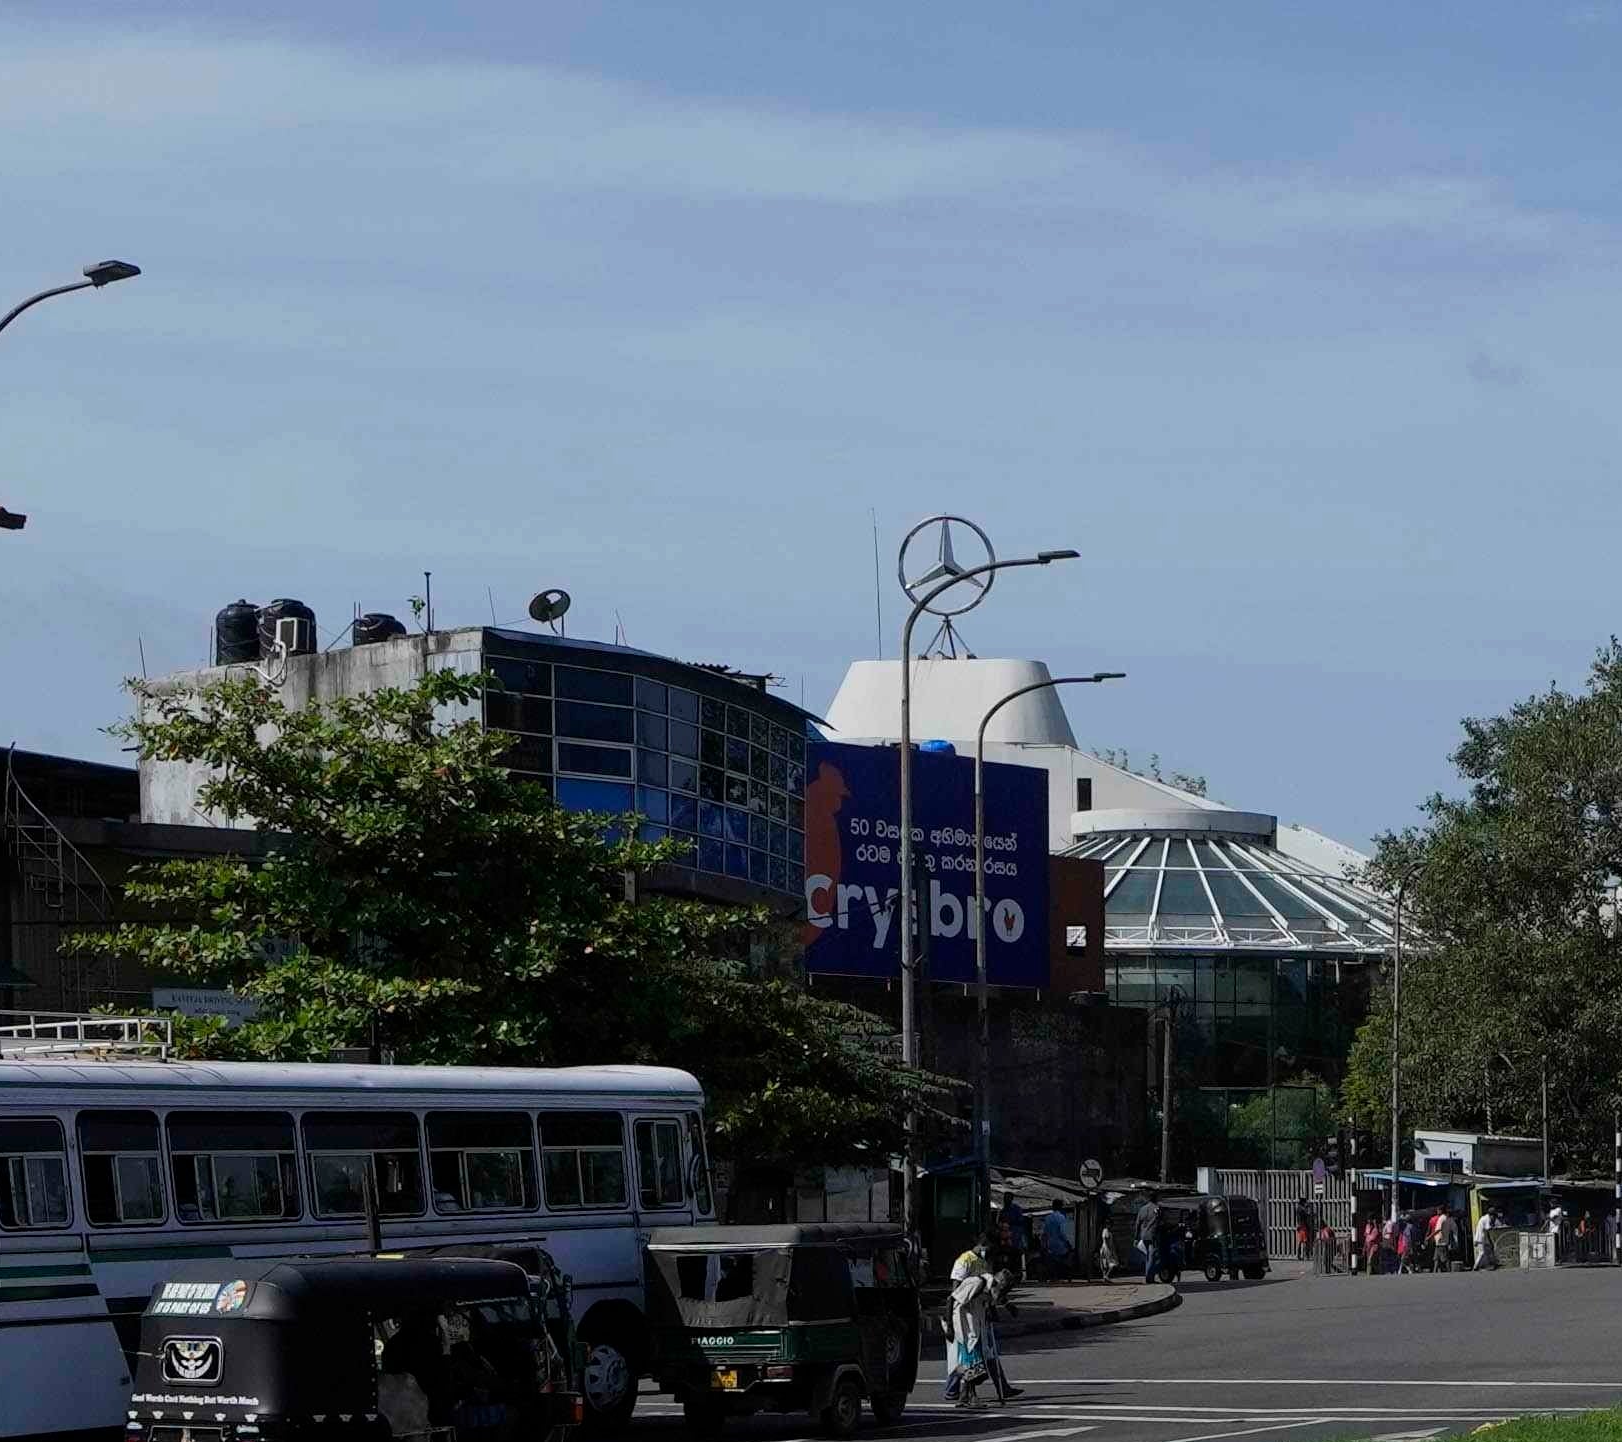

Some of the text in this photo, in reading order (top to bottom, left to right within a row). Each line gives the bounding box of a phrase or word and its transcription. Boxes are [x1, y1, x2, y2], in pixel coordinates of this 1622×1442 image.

[850, 818, 870, 836] 50
[875, 820, 925, 842] වසක
[856, 844, 891, 863] රටම
[983, 857, 1018, 876] රසය
[805, 874, 1025, 949] Crybro
[691, 1336, 734, 1345] PIAGGIO
[179, 1395, 204, 1405] Nothing
[217, 1396, 238, 1404] Worth
